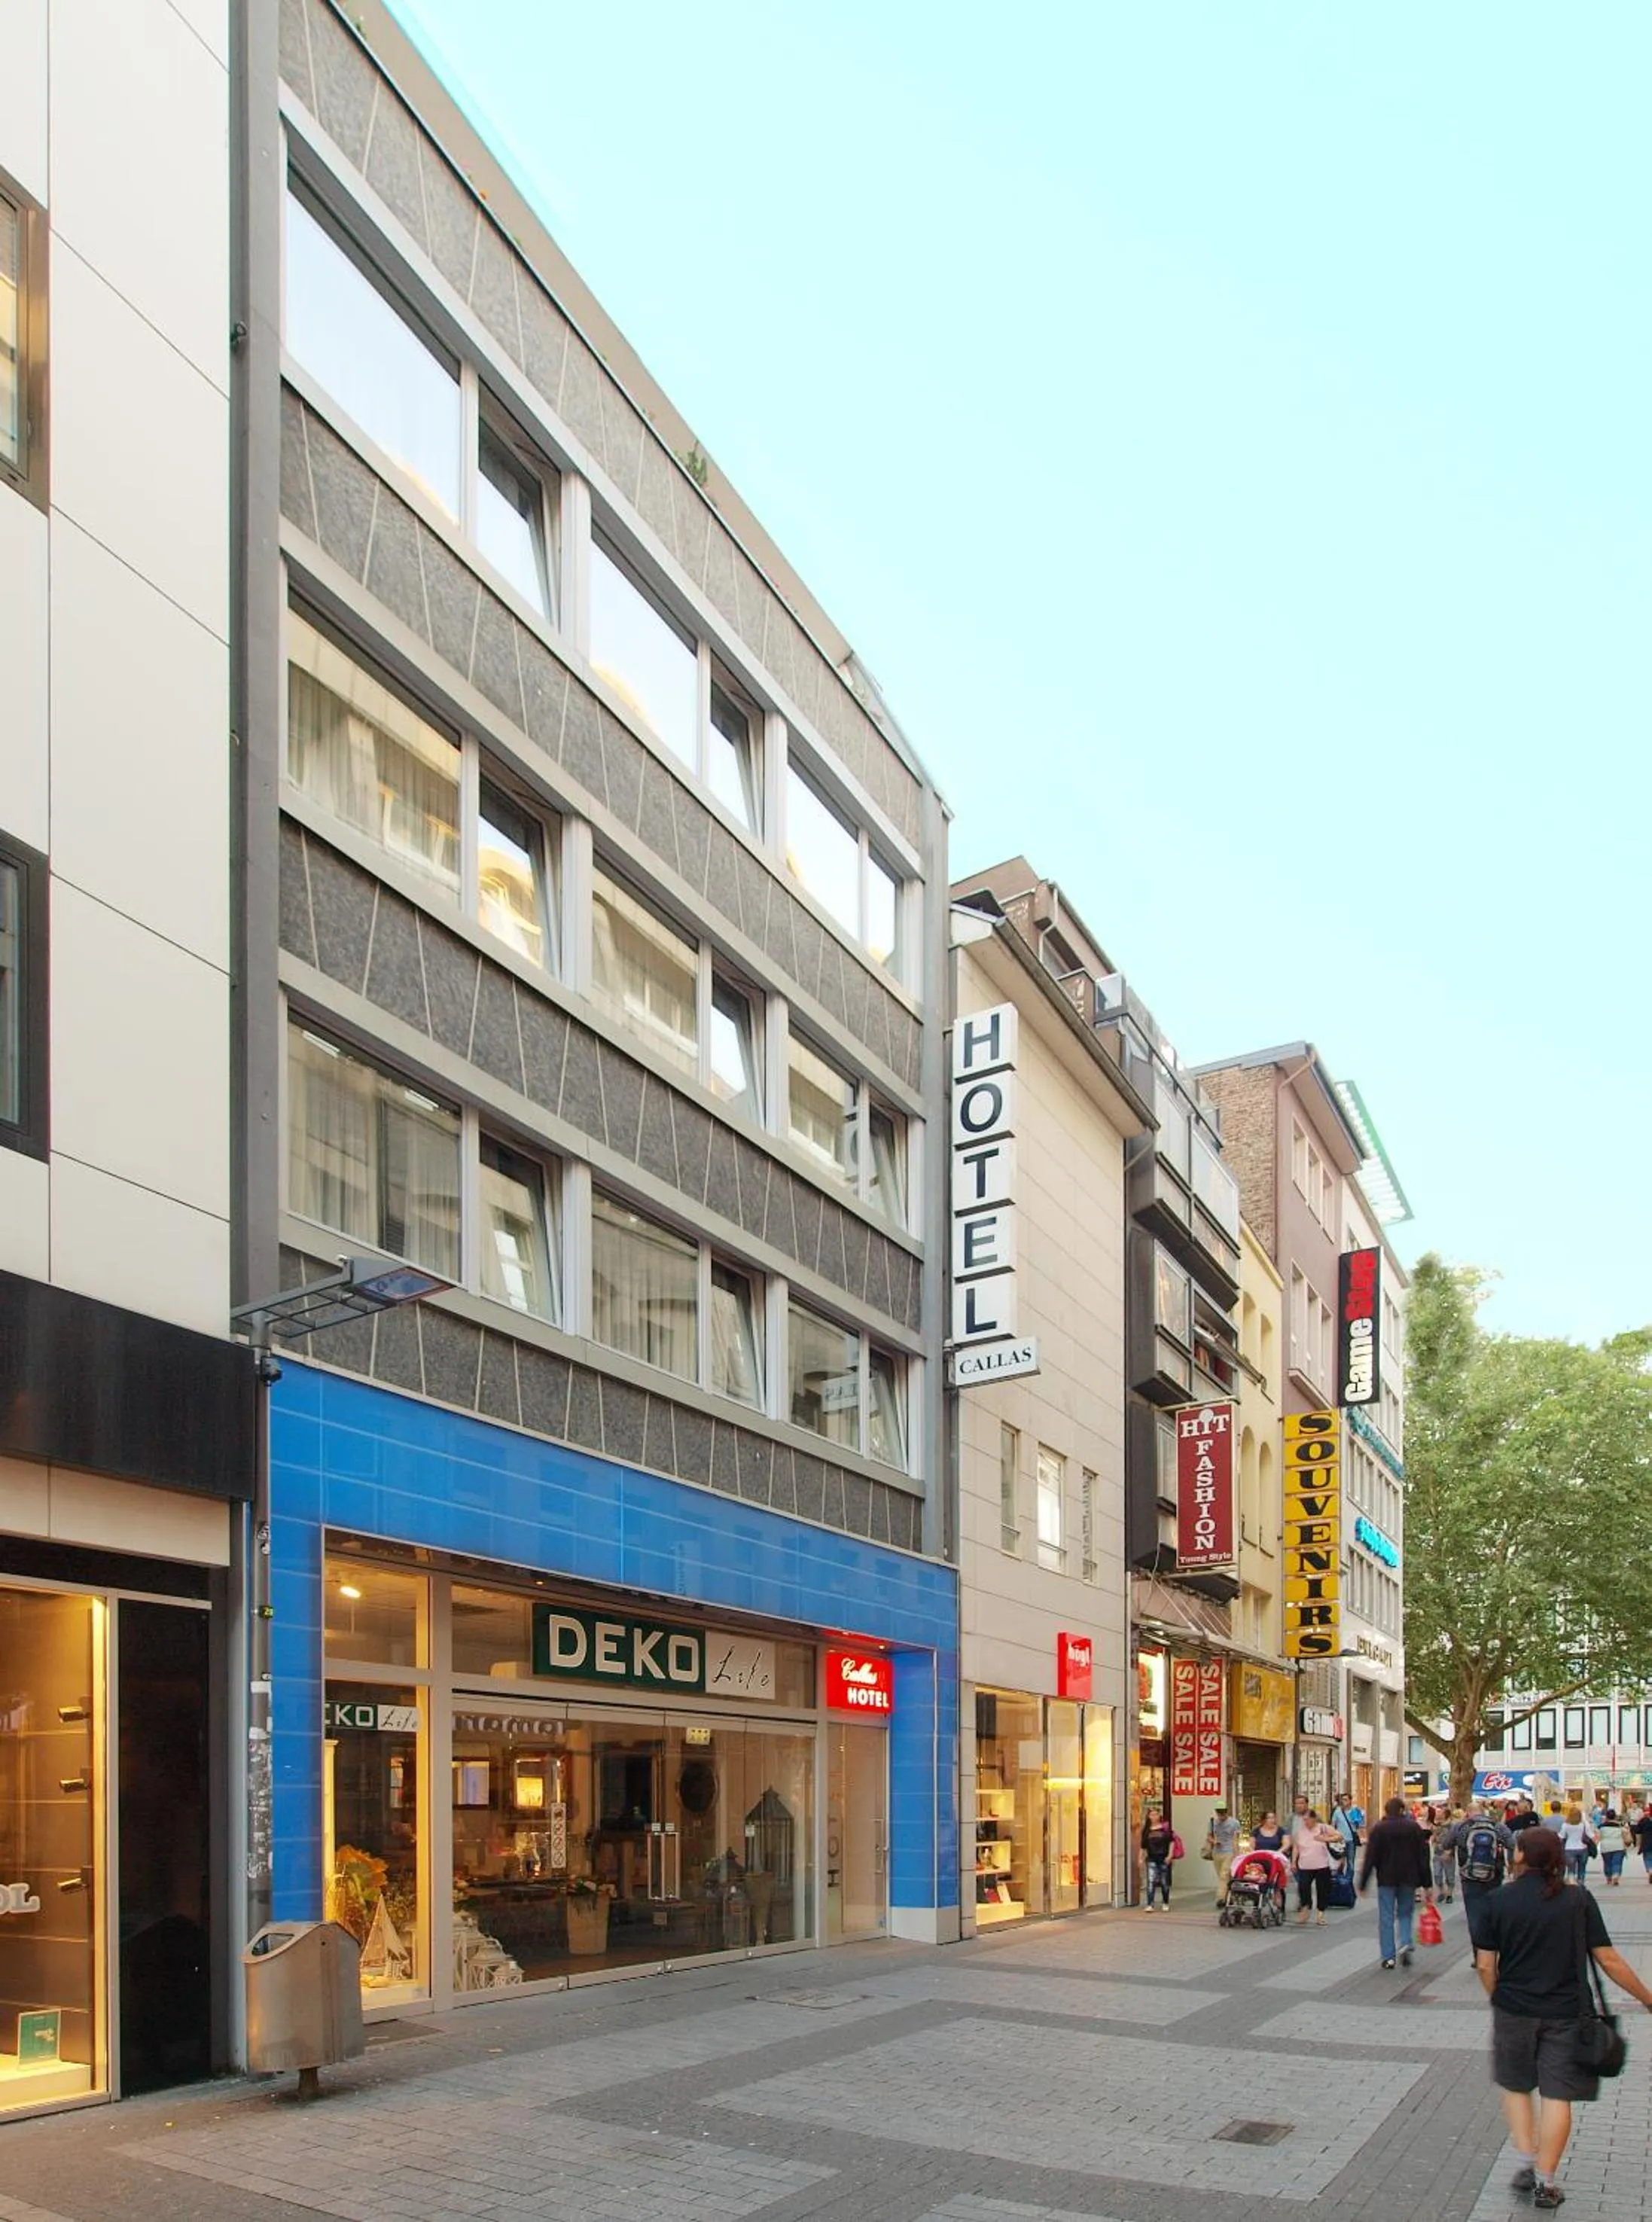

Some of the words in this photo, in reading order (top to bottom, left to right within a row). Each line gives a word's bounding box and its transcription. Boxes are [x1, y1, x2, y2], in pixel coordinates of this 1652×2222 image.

[960, 1013, 1002, 1334] HOTEL
[959, 1346, 1032, 1374] CALLAS
[1181, 1408, 1230, 1438] HIT
[1194, 1439, 1215, 1550] FASHION
[1179, 1555, 1208, 1564] Young
[1209, 1552, 1232, 1561] Style
[1295, 1413, 1336, 1655] SOUVENIRS
[549, 1614, 700, 1682] DEKO
[712, 1644, 770, 1690] Life
[847, 1687, 889, 1708] HOTEL
[1175, 1665, 1194, 1724] SALE
[1201, 1661, 1220, 1724] SALE
[1174, 1732, 1193, 1791] SALE
[1199, 1732, 1219, 1791] SALE
